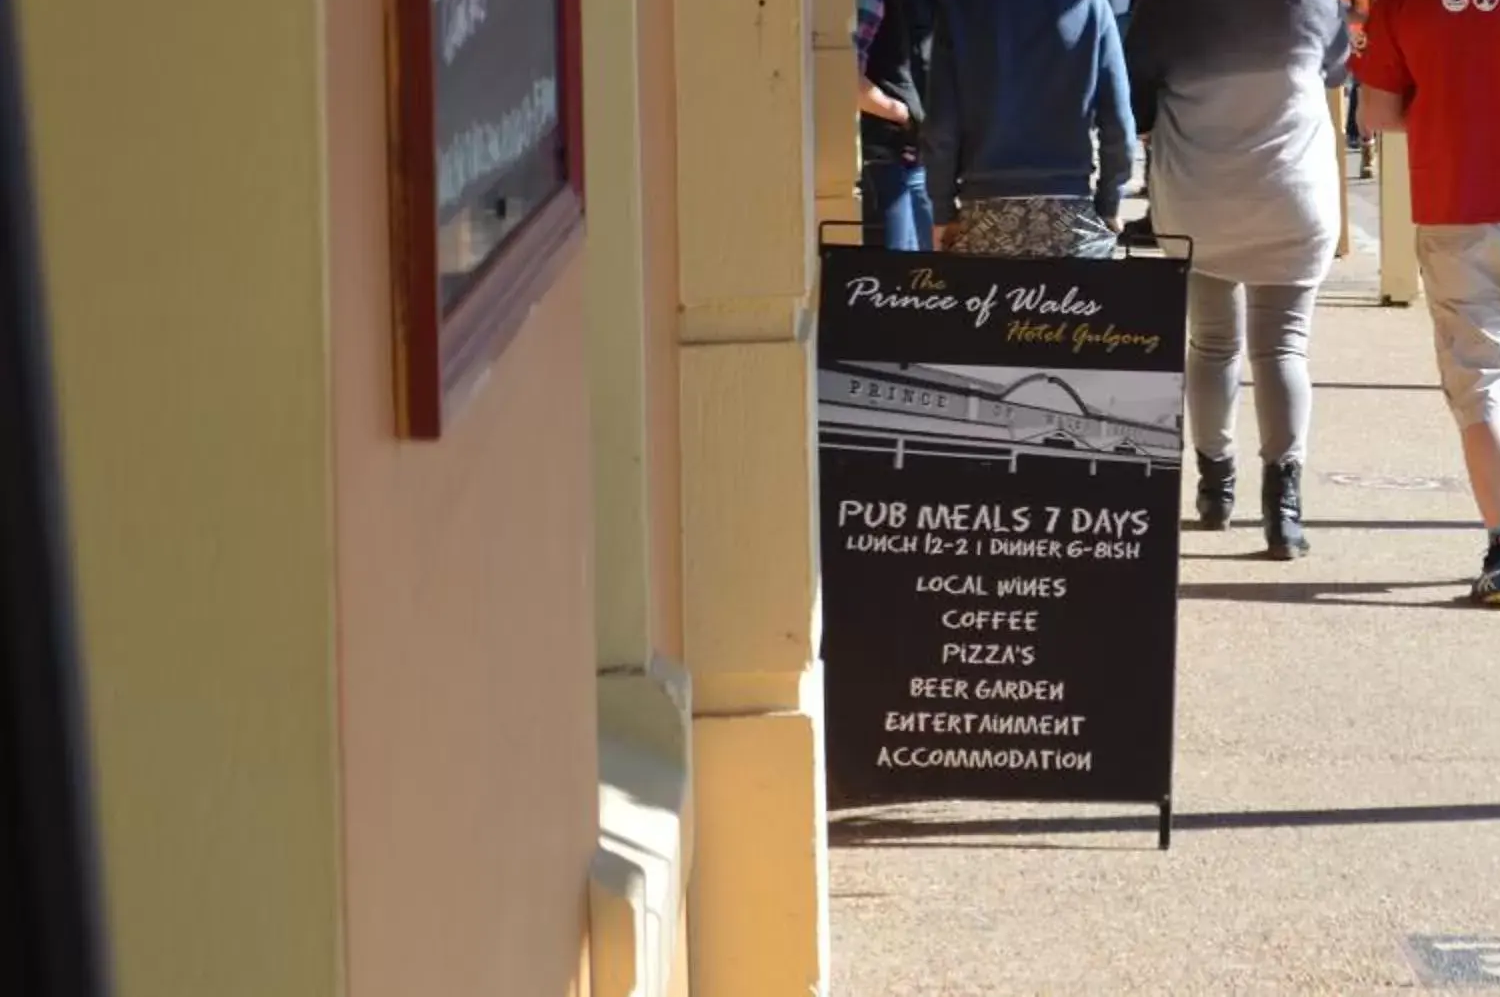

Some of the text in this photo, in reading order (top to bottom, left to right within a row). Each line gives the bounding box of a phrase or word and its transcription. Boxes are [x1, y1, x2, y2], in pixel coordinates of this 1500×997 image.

[911, 267, 945, 290] The
[848, 274, 1101, 327] Prince of Wales
[1007, 320, 1161, 351] Hotel Gulgong
[839, 501, 1148, 539] PUB MEALS 7 DAYS
[847, 535, 917, 553] LUNCH
[916, 575, 1066, 597] LOCAL WINES
[942, 610, 1038, 631] COFFEE
[910, 677, 1064, 700] BEER GARDEN
[885, 711, 1085, 735] ENTERTAINMENT
[877, 746, 1092, 771] ACCOMMODATION
